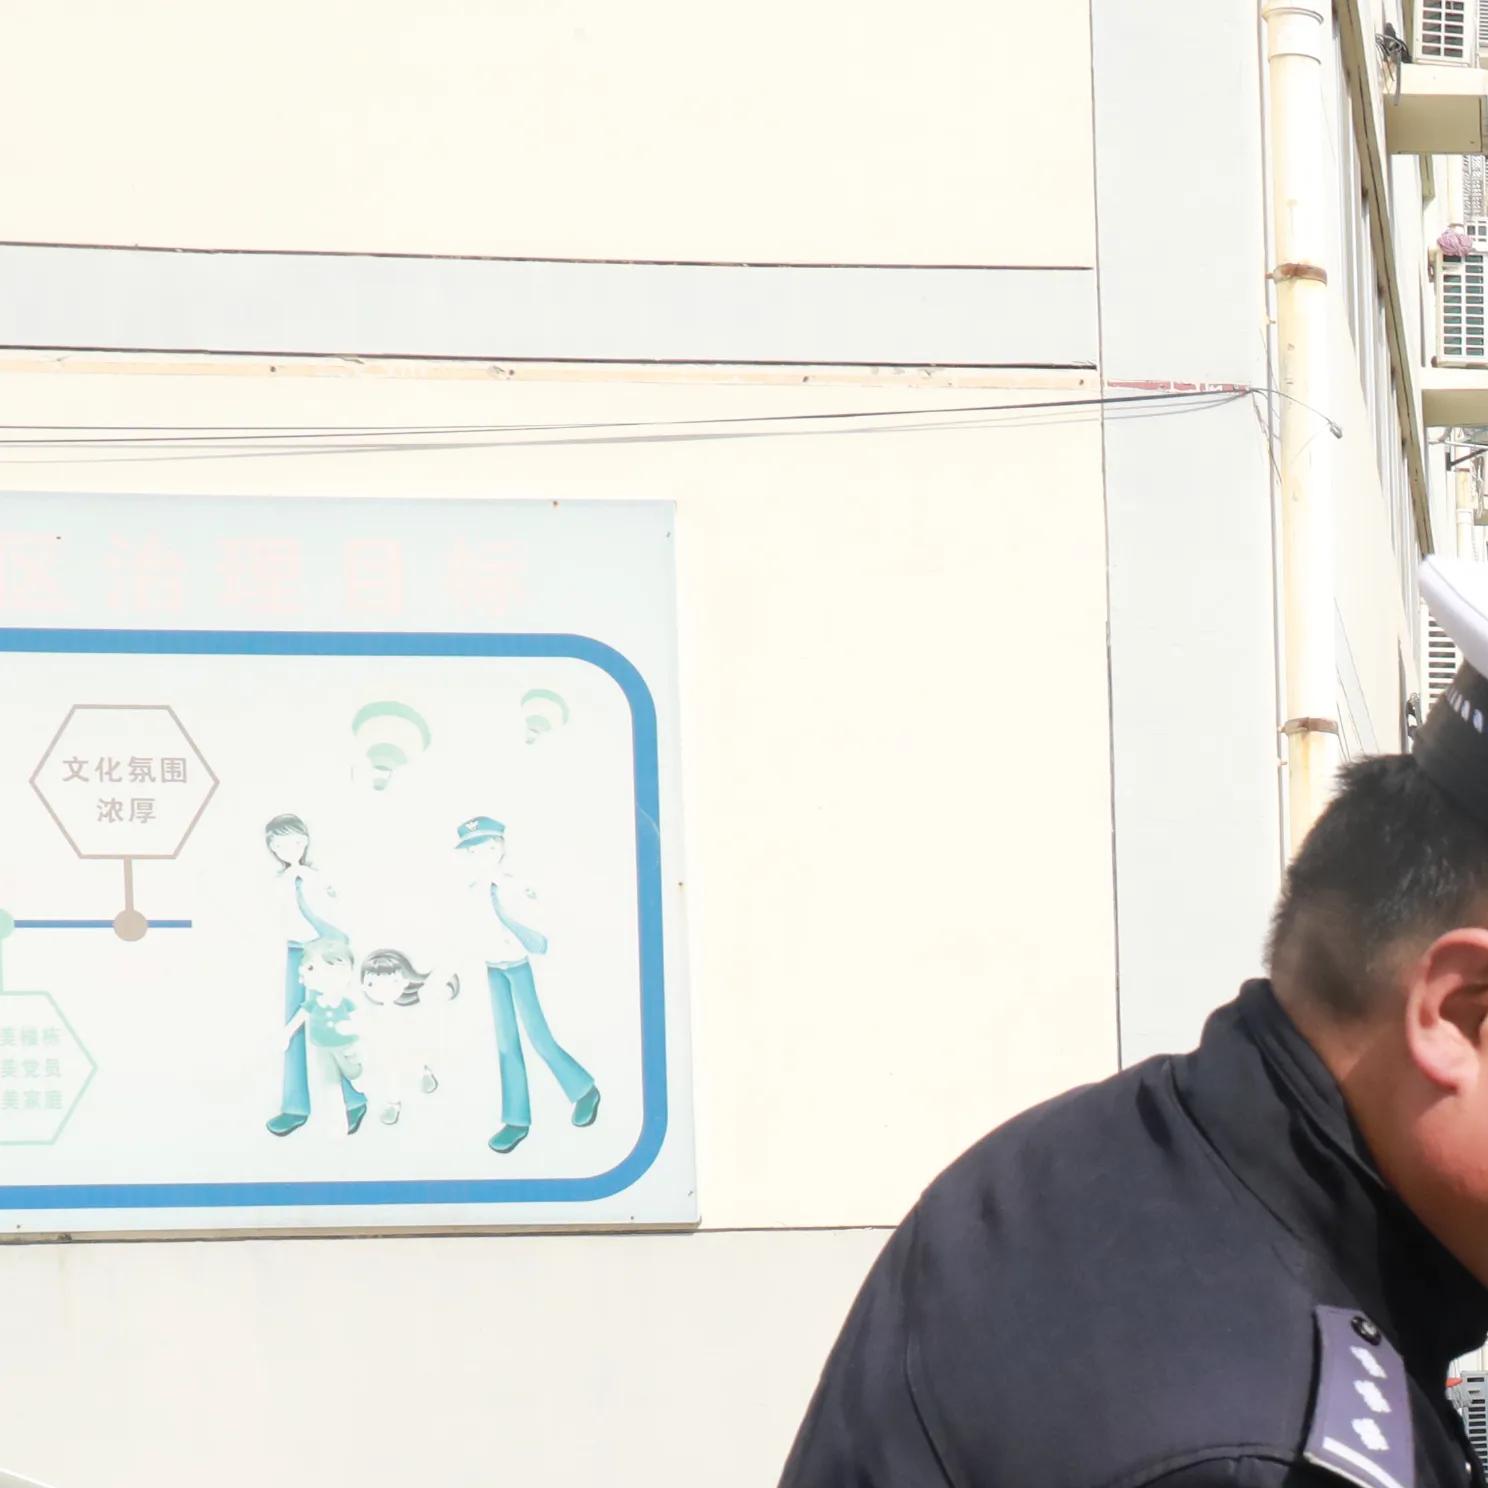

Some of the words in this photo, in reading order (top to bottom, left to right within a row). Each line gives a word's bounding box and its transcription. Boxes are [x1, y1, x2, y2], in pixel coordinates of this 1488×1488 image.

[62, 755, 188, 784] 文化氛围
[96, 797, 158, 824] 浓厚
